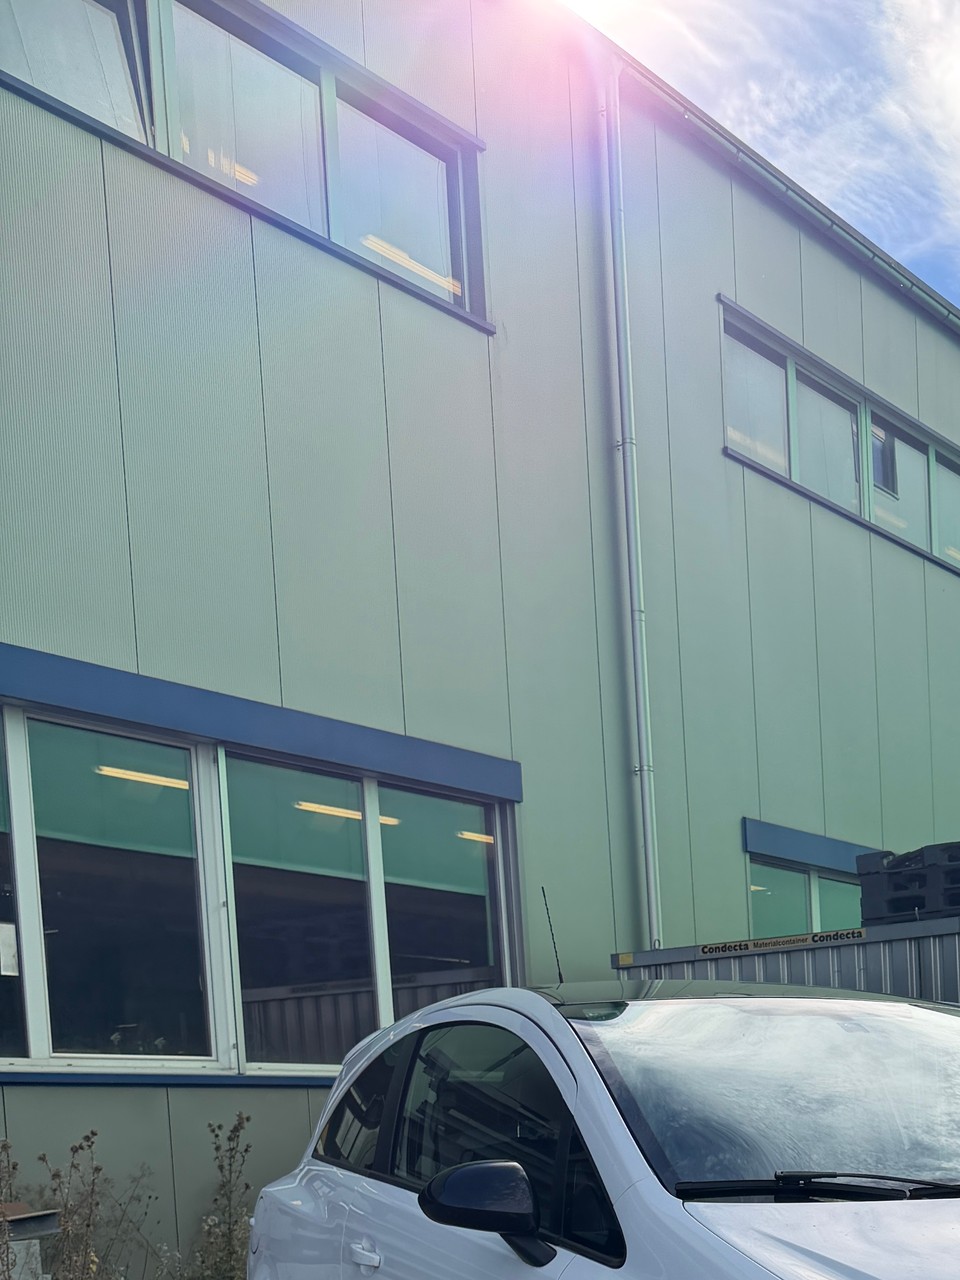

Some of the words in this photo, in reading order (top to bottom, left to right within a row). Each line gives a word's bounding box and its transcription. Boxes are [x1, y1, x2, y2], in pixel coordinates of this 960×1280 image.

[701, 942, 749, 954] Condecta
[753, 937, 808, 949] Materialcontainer
[811, 929, 863, 944] Condecta
